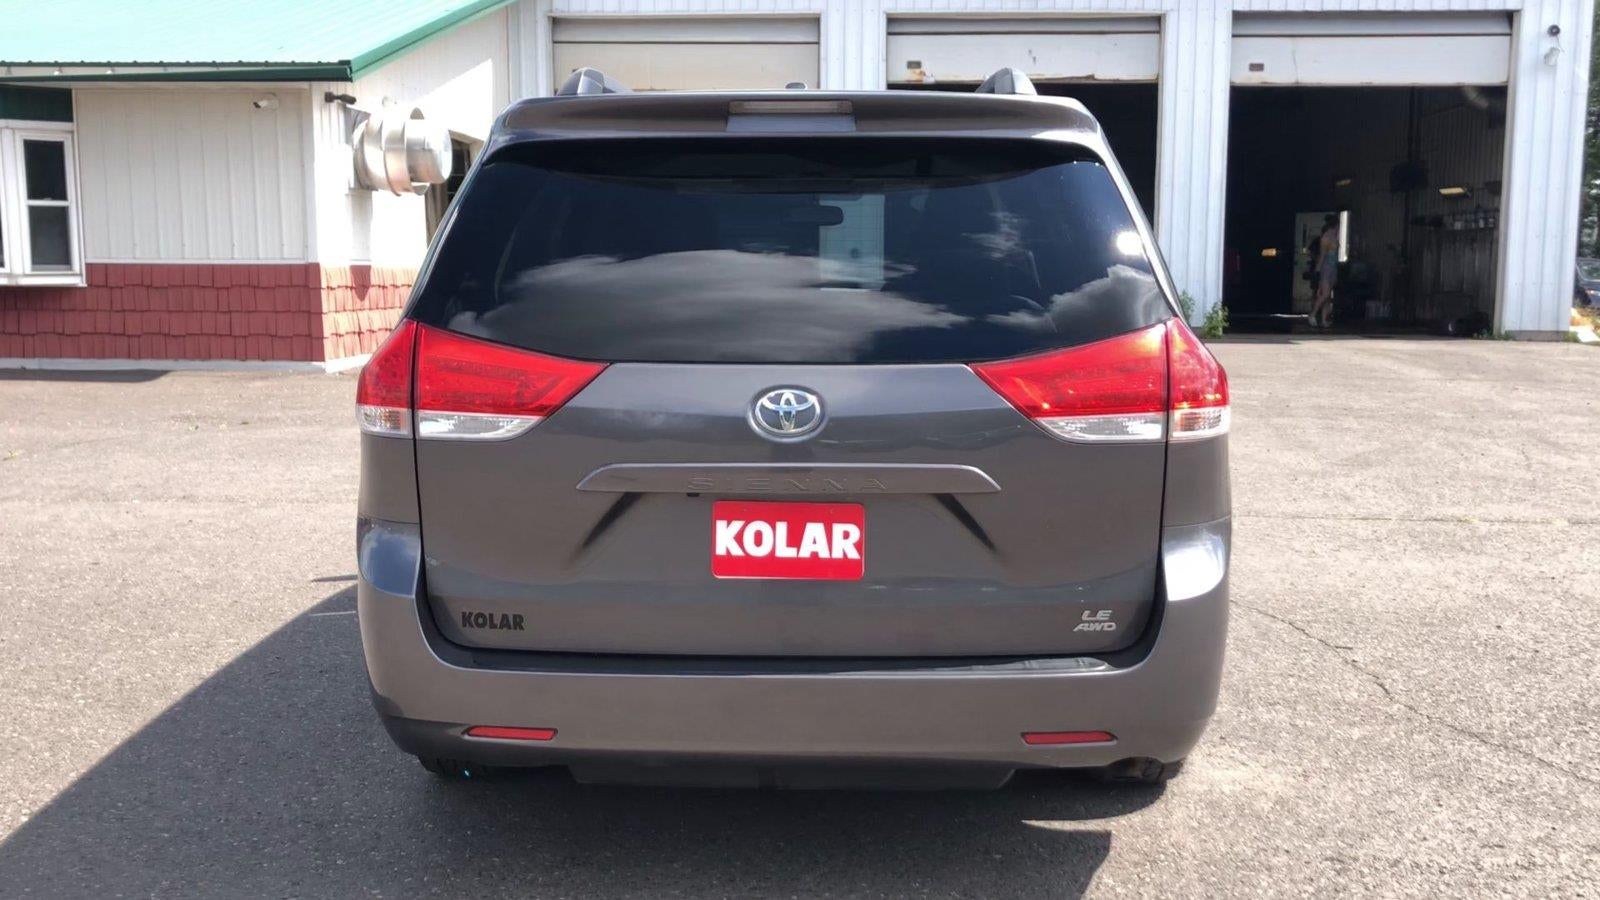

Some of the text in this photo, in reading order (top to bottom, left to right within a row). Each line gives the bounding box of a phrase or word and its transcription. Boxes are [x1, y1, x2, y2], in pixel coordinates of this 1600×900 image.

[687, 477, 888, 491] SIENNA
[715, 519, 861, 560] KOLAR
[461, 611, 525, 631] KOLAR
[1081, 610, 1112, 621] LE
[1072, 622, 1117, 631] AWD
